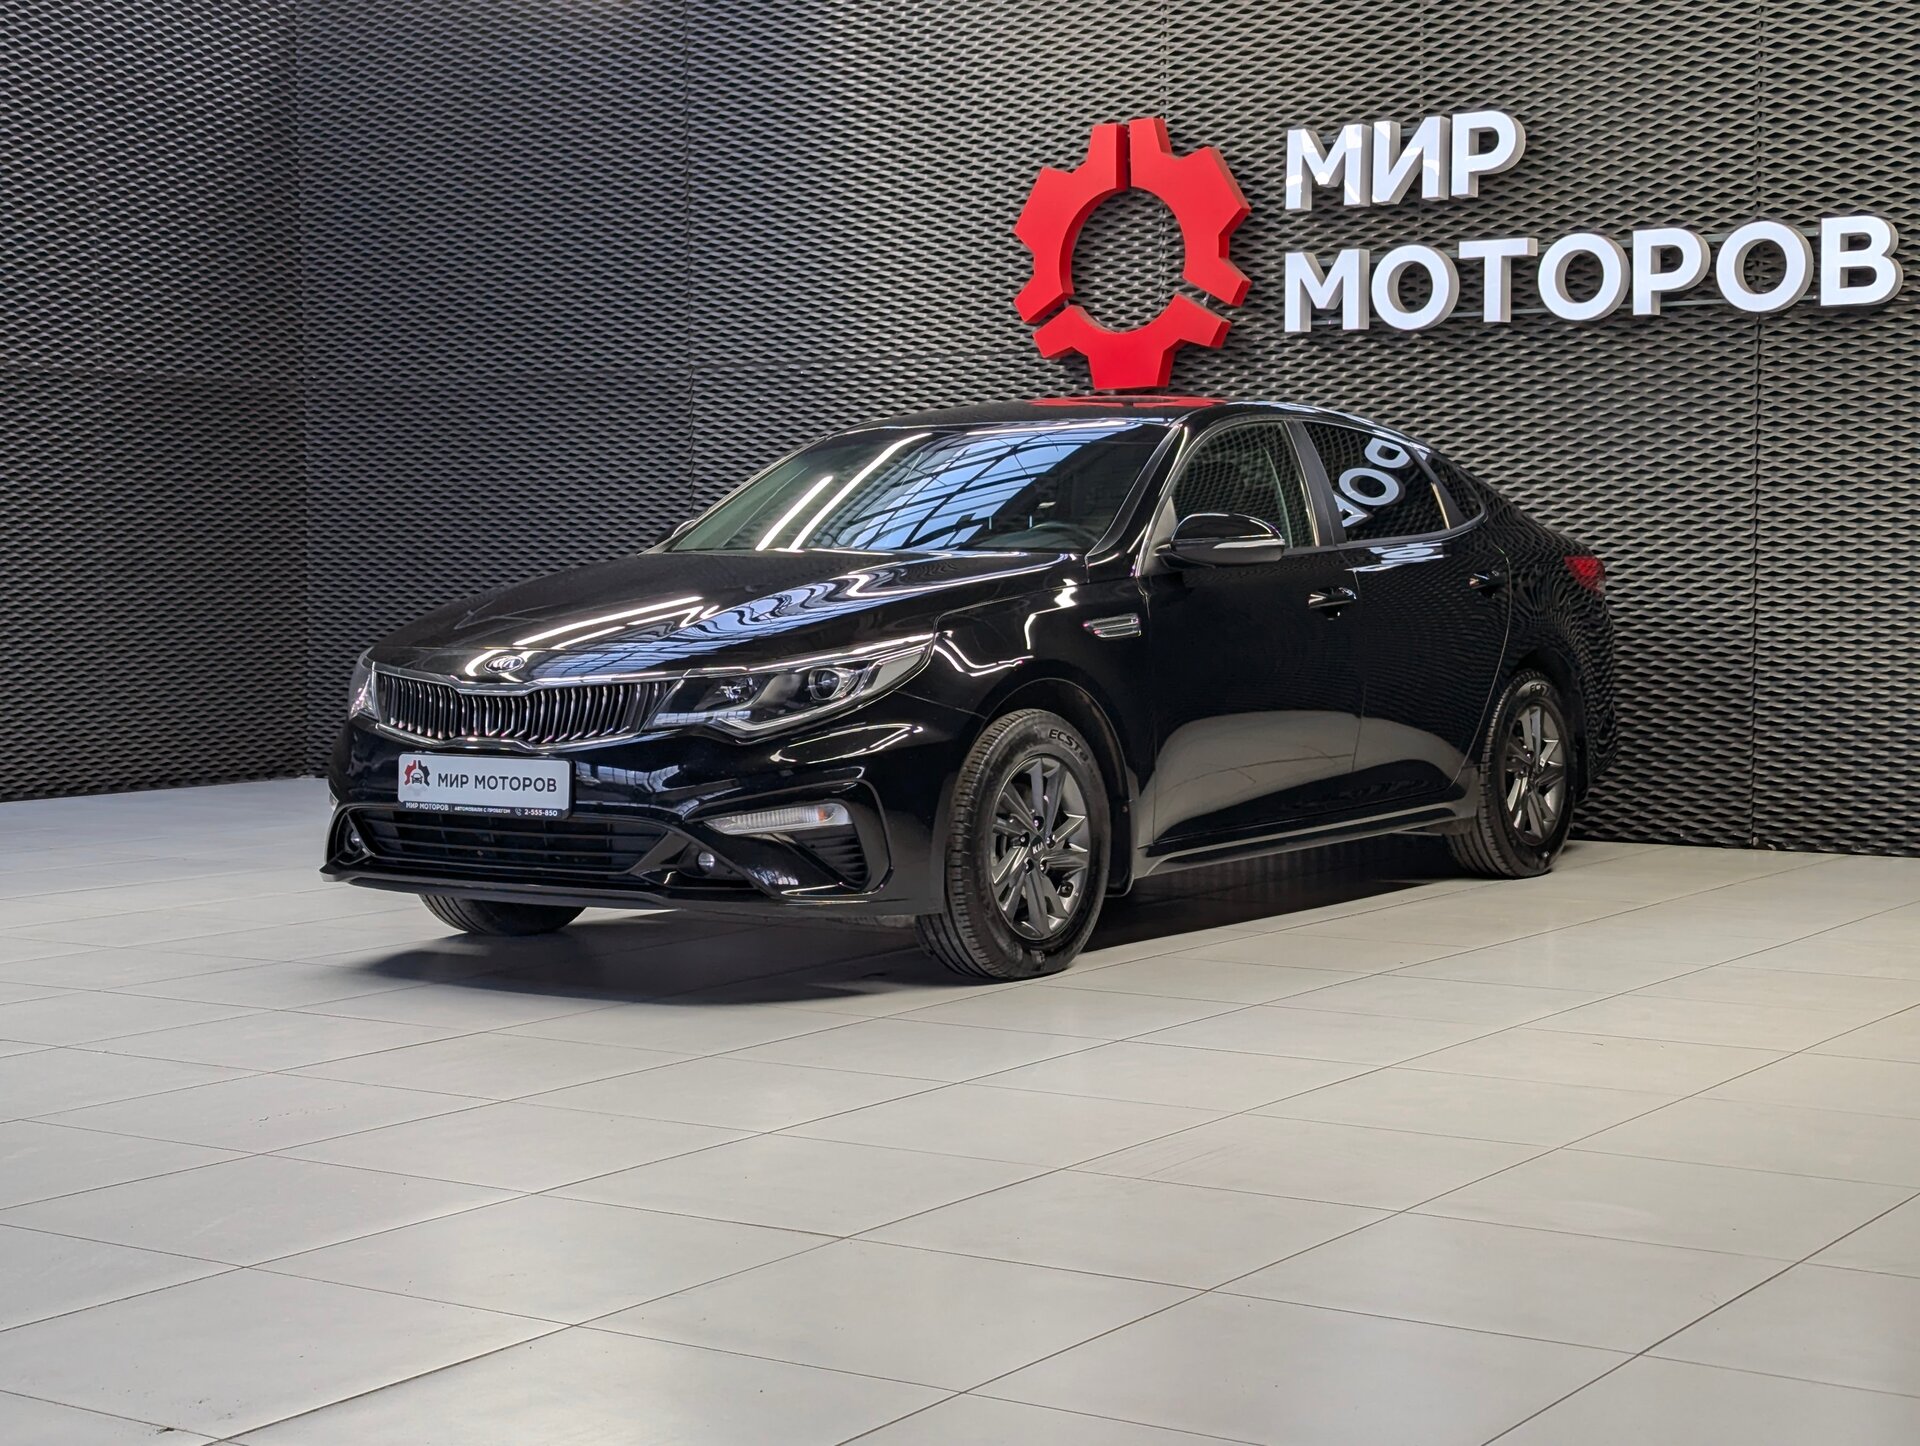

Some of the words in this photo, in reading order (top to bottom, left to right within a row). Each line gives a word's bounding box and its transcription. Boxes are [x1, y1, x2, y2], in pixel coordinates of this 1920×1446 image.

[1285, 110, 1527, 210] МИР
[1283, 214, 1904, 333] МОТОРОВ
[438, 773, 469, 789] МИР
[475, 775, 557, 793] МОТОРОВ
[419, 803, 449, 811] МОТОРОВ
[524, 808, 558, 817] 2-555-850
